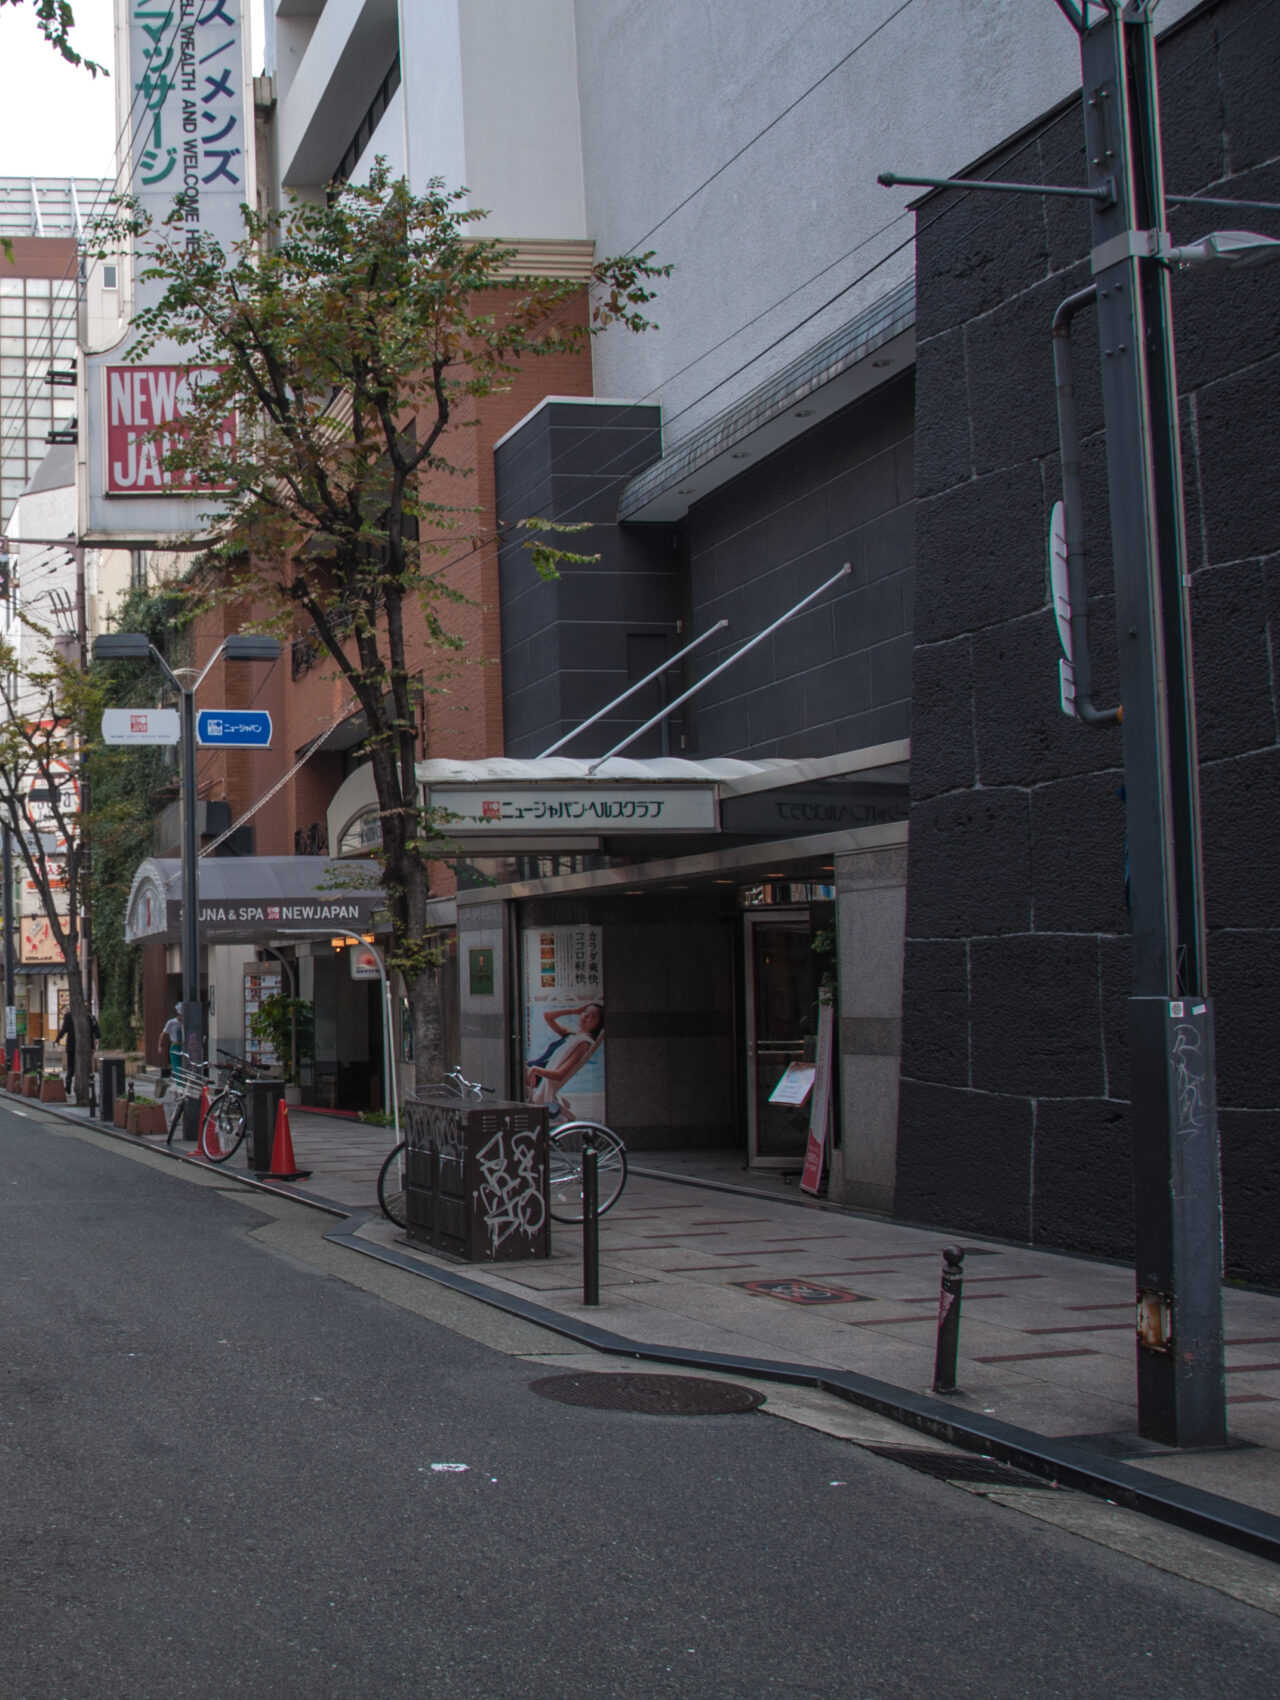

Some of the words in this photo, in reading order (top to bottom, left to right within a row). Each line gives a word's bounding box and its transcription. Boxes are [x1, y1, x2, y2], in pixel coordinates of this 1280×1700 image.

[180, 26, 196, 91] WEALTH
[134, 0, 177, 186] マッサージ
[182, 99, 197, 133] AND
[182, 138, 199, 223] WELCOME
[110, 372, 177, 426] NEW
[113, 430, 236, 487] JAP
[224, 724, 262, 733] ニュージャパン
[180, 908, 226, 921] UNA
[228, 909, 237, 921] &
[239, 907, 264, 920] SPA
[282, 905, 359, 919] NEWJAPAN
